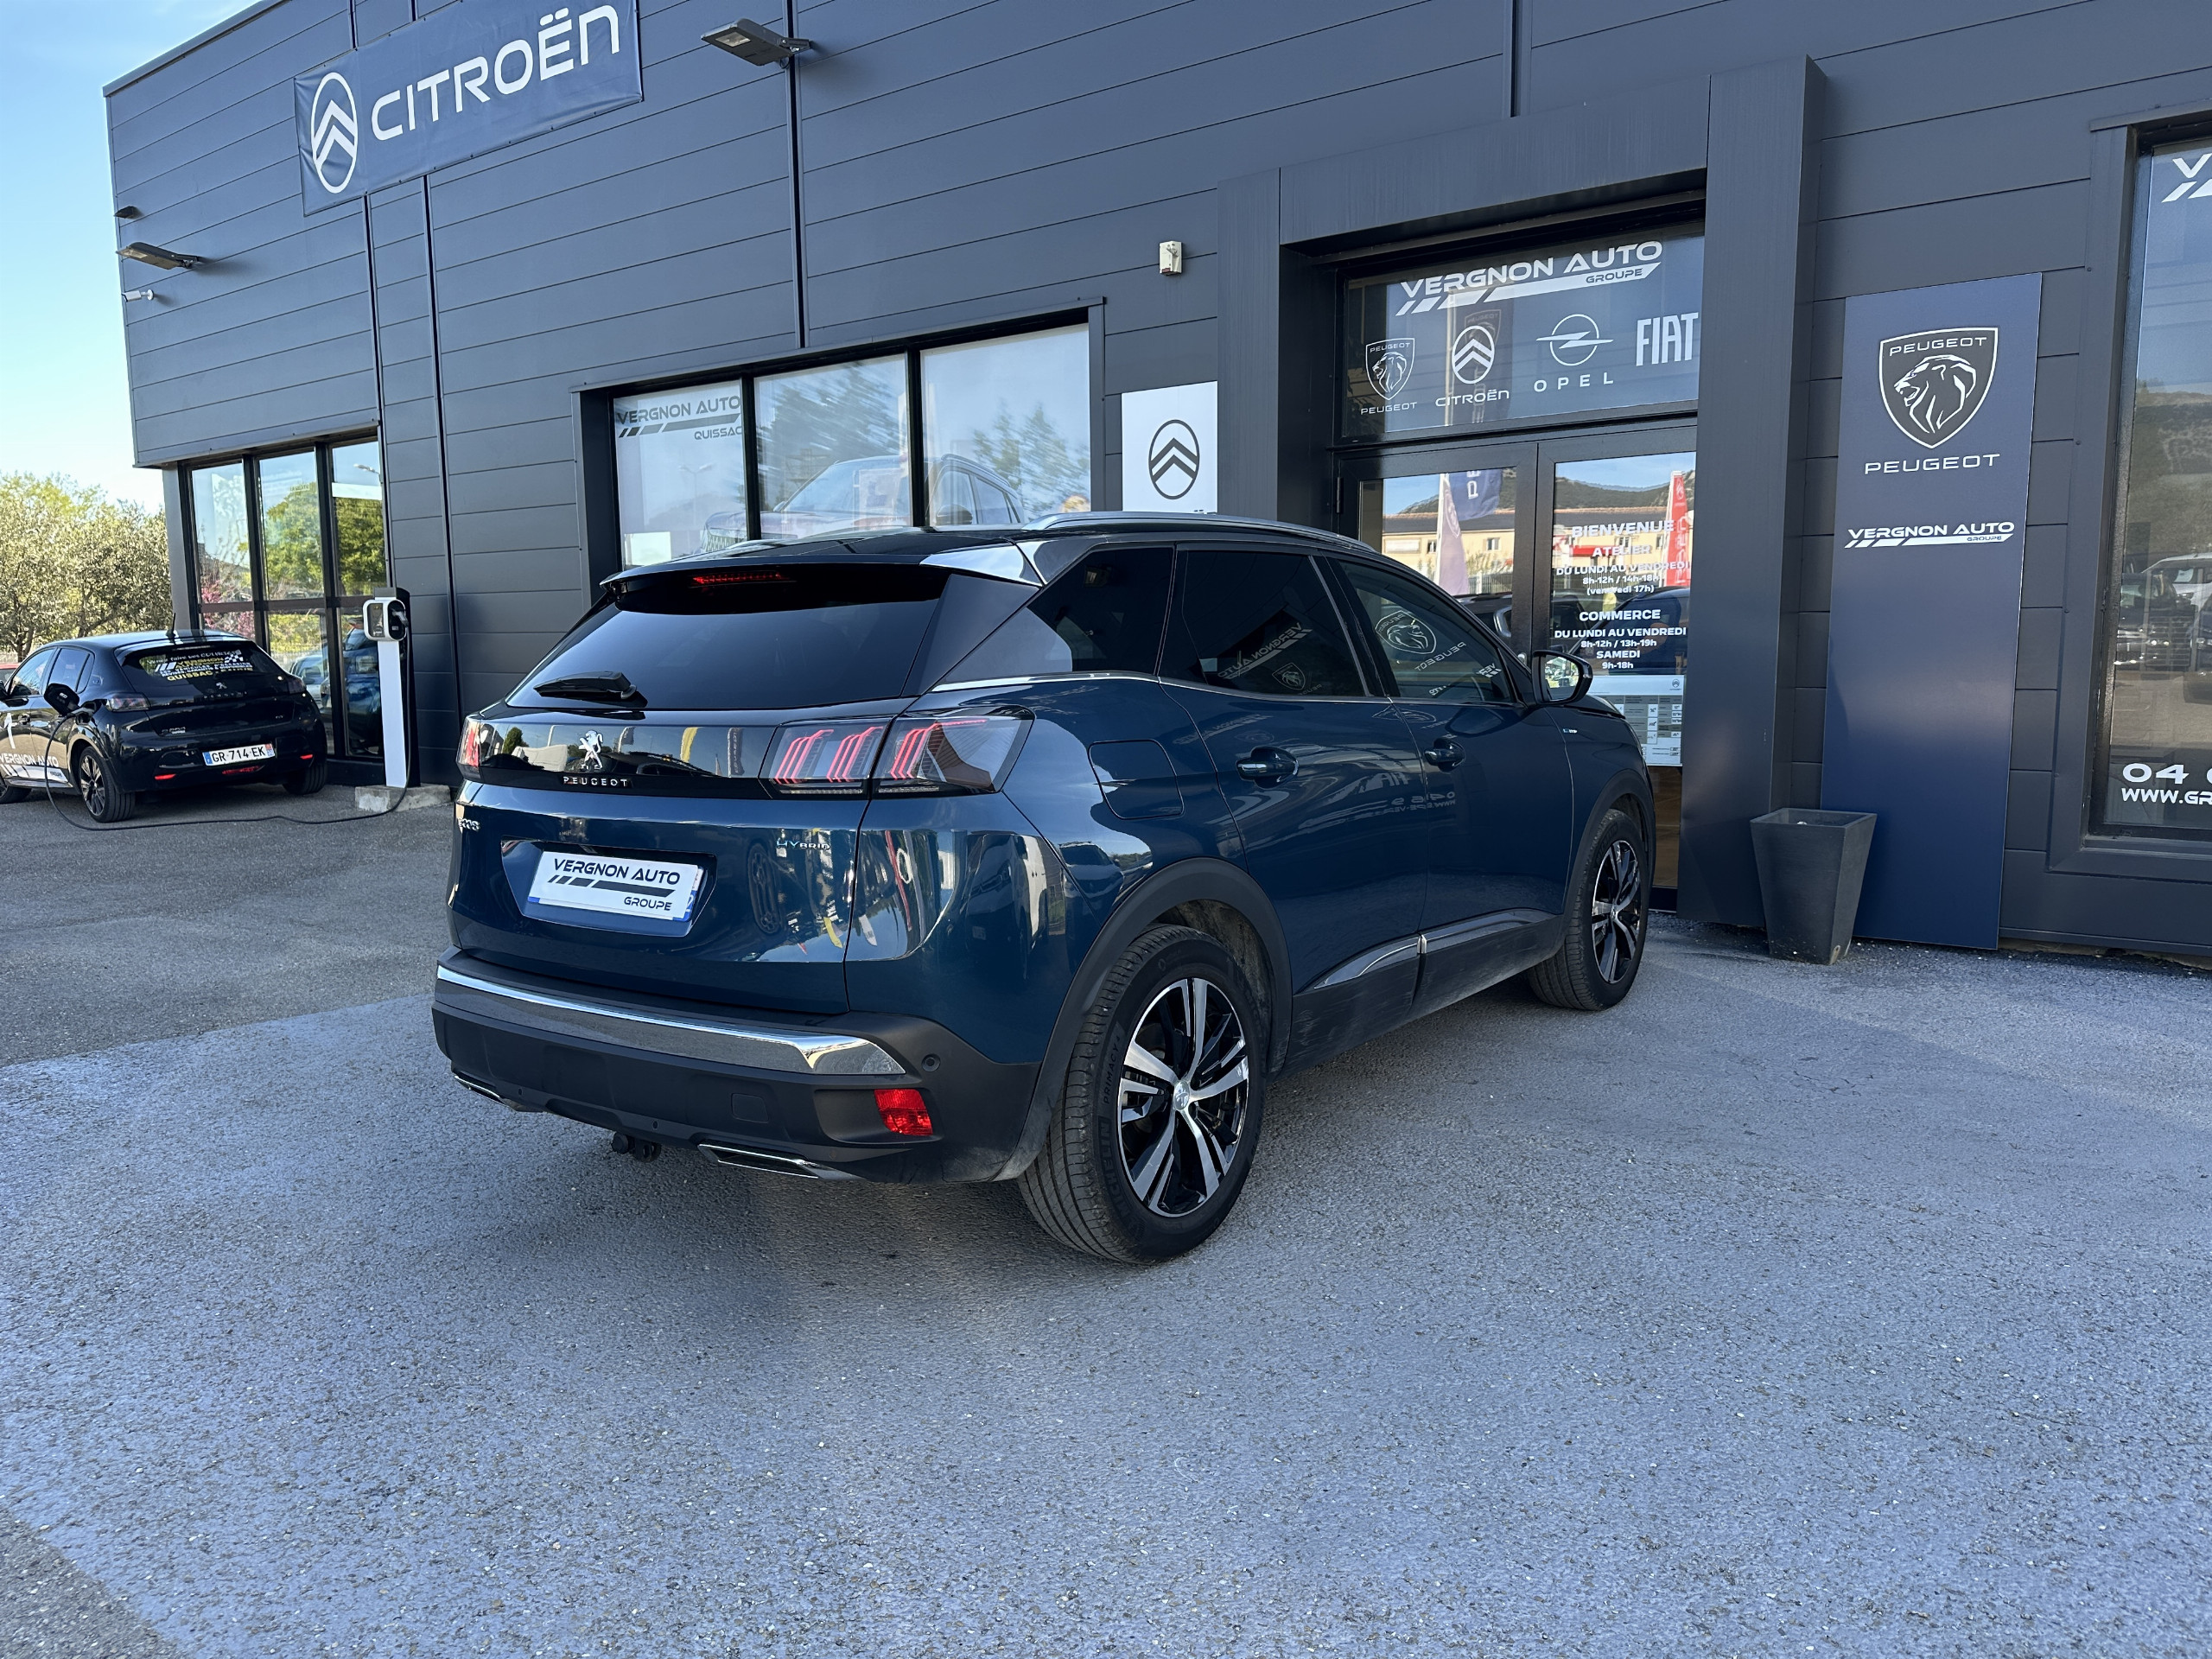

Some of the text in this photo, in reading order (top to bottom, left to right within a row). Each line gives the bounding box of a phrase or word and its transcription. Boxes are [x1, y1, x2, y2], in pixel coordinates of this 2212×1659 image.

[371, 4, 620, 141] CITROËN
[1400, 241, 1663, 298] VERGNON AUTO
[1586, 268, 1644, 283] GROUPE
[1370, 342, 1411, 353] PEUGEOT
[1636, 312, 1699, 367] FIAT
[1889, 336, 1987, 357] PEUGEOT
[1533, 372, 1614, 393] OPEL
[1435, 389, 1510, 407] CITROËN
[617, 396, 741, 424] VERGNON AUTO
[1360, 402, 1418, 415] PEUGEOT
[694, 426, 742, 440] QUISSAC
[1865, 454, 2000, 474] PEUGEOT
[1572, 519, 1675, 537] BIENVENUE
[1847, 521, 2015, 539] VERGNON AUTO
[1592, 544, 1652, 557] ATELIER
[1556, 561, 1689, 575] DU LUNDI AU VENDREDI
[1634, 584, 1654, 593] 17h)
[1579, 609, 1661, 621] COMMERCE
[1554, 627, 1686, 639] DU LUNDI AU VENDREDI
[1596, 650, 1640, 658] SAMEDI
[563, 776, 628, 787] PEUGEOT
[2122, 763, 2190, 784] 04
[554, 858, 681, 886] VERGNON AUTO
[624, 896, 672, 912] GROUPE
